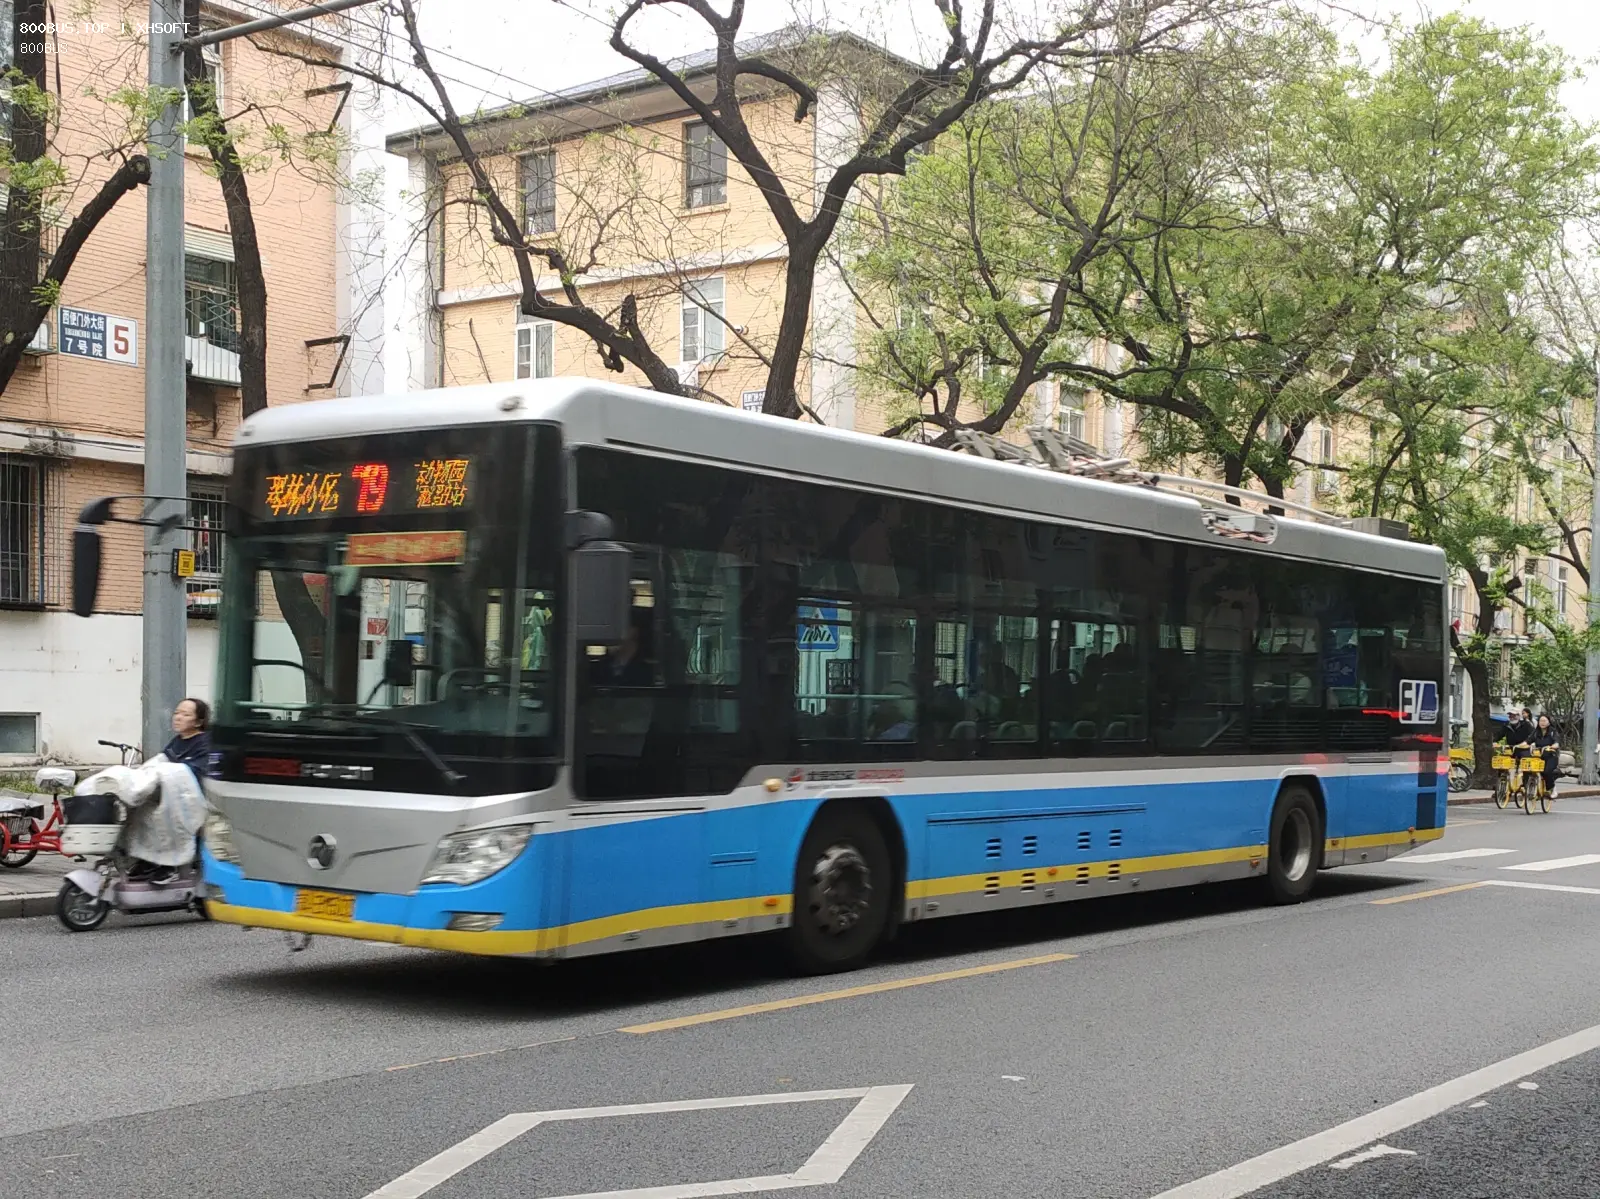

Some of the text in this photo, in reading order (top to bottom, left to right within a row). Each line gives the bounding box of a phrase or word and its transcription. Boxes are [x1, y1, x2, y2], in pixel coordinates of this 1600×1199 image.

[62, 309, 105, 331] 西便门外大街
[65, 337, 103, 357] 7号院
[114, 324, 129, 355] 5
[414, 459, 469, 485] 动物园
[265, 472, 342, 516] 翠林小区
